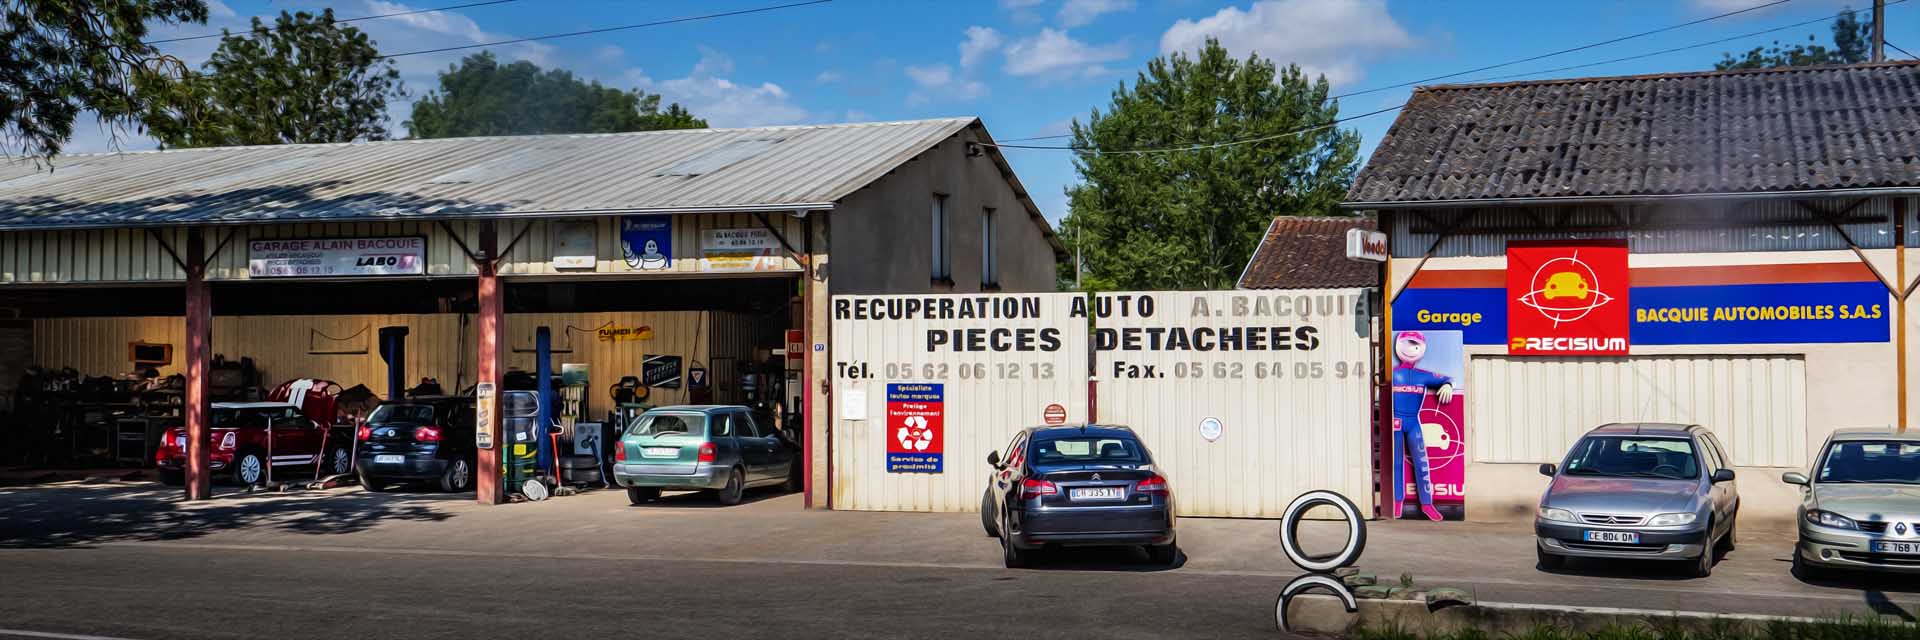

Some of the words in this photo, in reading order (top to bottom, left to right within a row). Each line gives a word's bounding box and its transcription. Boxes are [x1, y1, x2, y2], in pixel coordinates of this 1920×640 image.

[252, 240, 307, 251] GARAGE
[313, 239, 353, 250] ALAIN
[356, 256, 397, 266] LABO
[835, 297, 1041, 320] RECUPERATION
[1069, 295, 1154, 318] AUTO
[1636, 308, 1709, 323] BACQUIE
[1713, 305, 1835, 321] AUTOMOBILES
[1839, 304, 1882, 319] S.A.S
[1416, 309, 1482, 326] Garage
[927, 328, 1061, 352] PIECES
[1096, 326, 1320, 352] DETACHEES
[1511, 337, 1626, 351] PRECISIUM
[837, 360, 874, 379] Tél.
[886, 362, 913, 379] 05
[922, 362, 949, 379] 62
[959, 362, 986, 379] 06
[996, 362, 1020, 379] 12
[1030, 362, 1055, 379] 13
[1114, 361, 1164, 379] Fax.
[1174, 361, 1203, 379] 05
[1213, 361, 1243, 379] 62
[1254, 361, 1283, 379] 64
[1294, 361, 1324, 379] 05
[1334, 361, 1365, 379] 94
[1876, 542, 1888, 551] CE
[1892, 543, 1910, 552] 768
